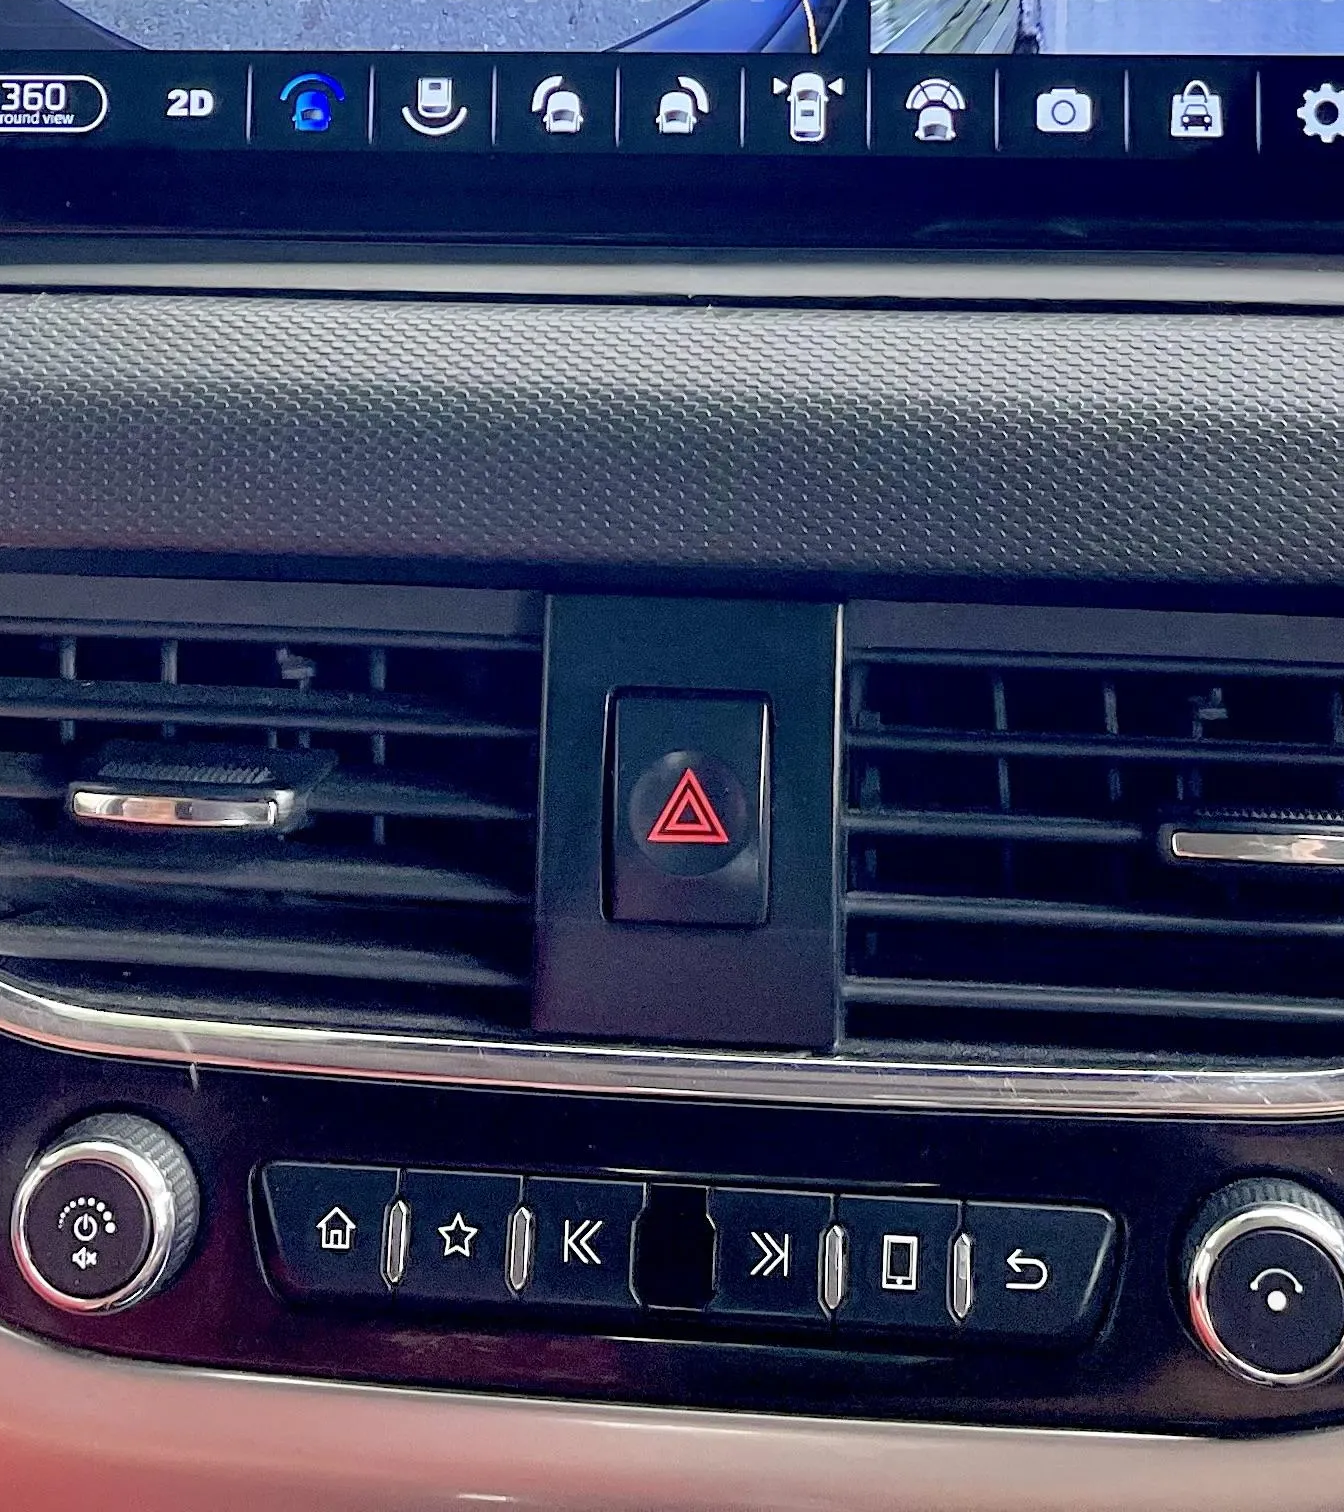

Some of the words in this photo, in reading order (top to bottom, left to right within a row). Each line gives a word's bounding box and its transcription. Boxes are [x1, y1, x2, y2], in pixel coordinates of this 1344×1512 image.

[0, 82, 66, 111] 360
[166, 89, 214, 117] 2D
[42, 110, 74, 126] view
